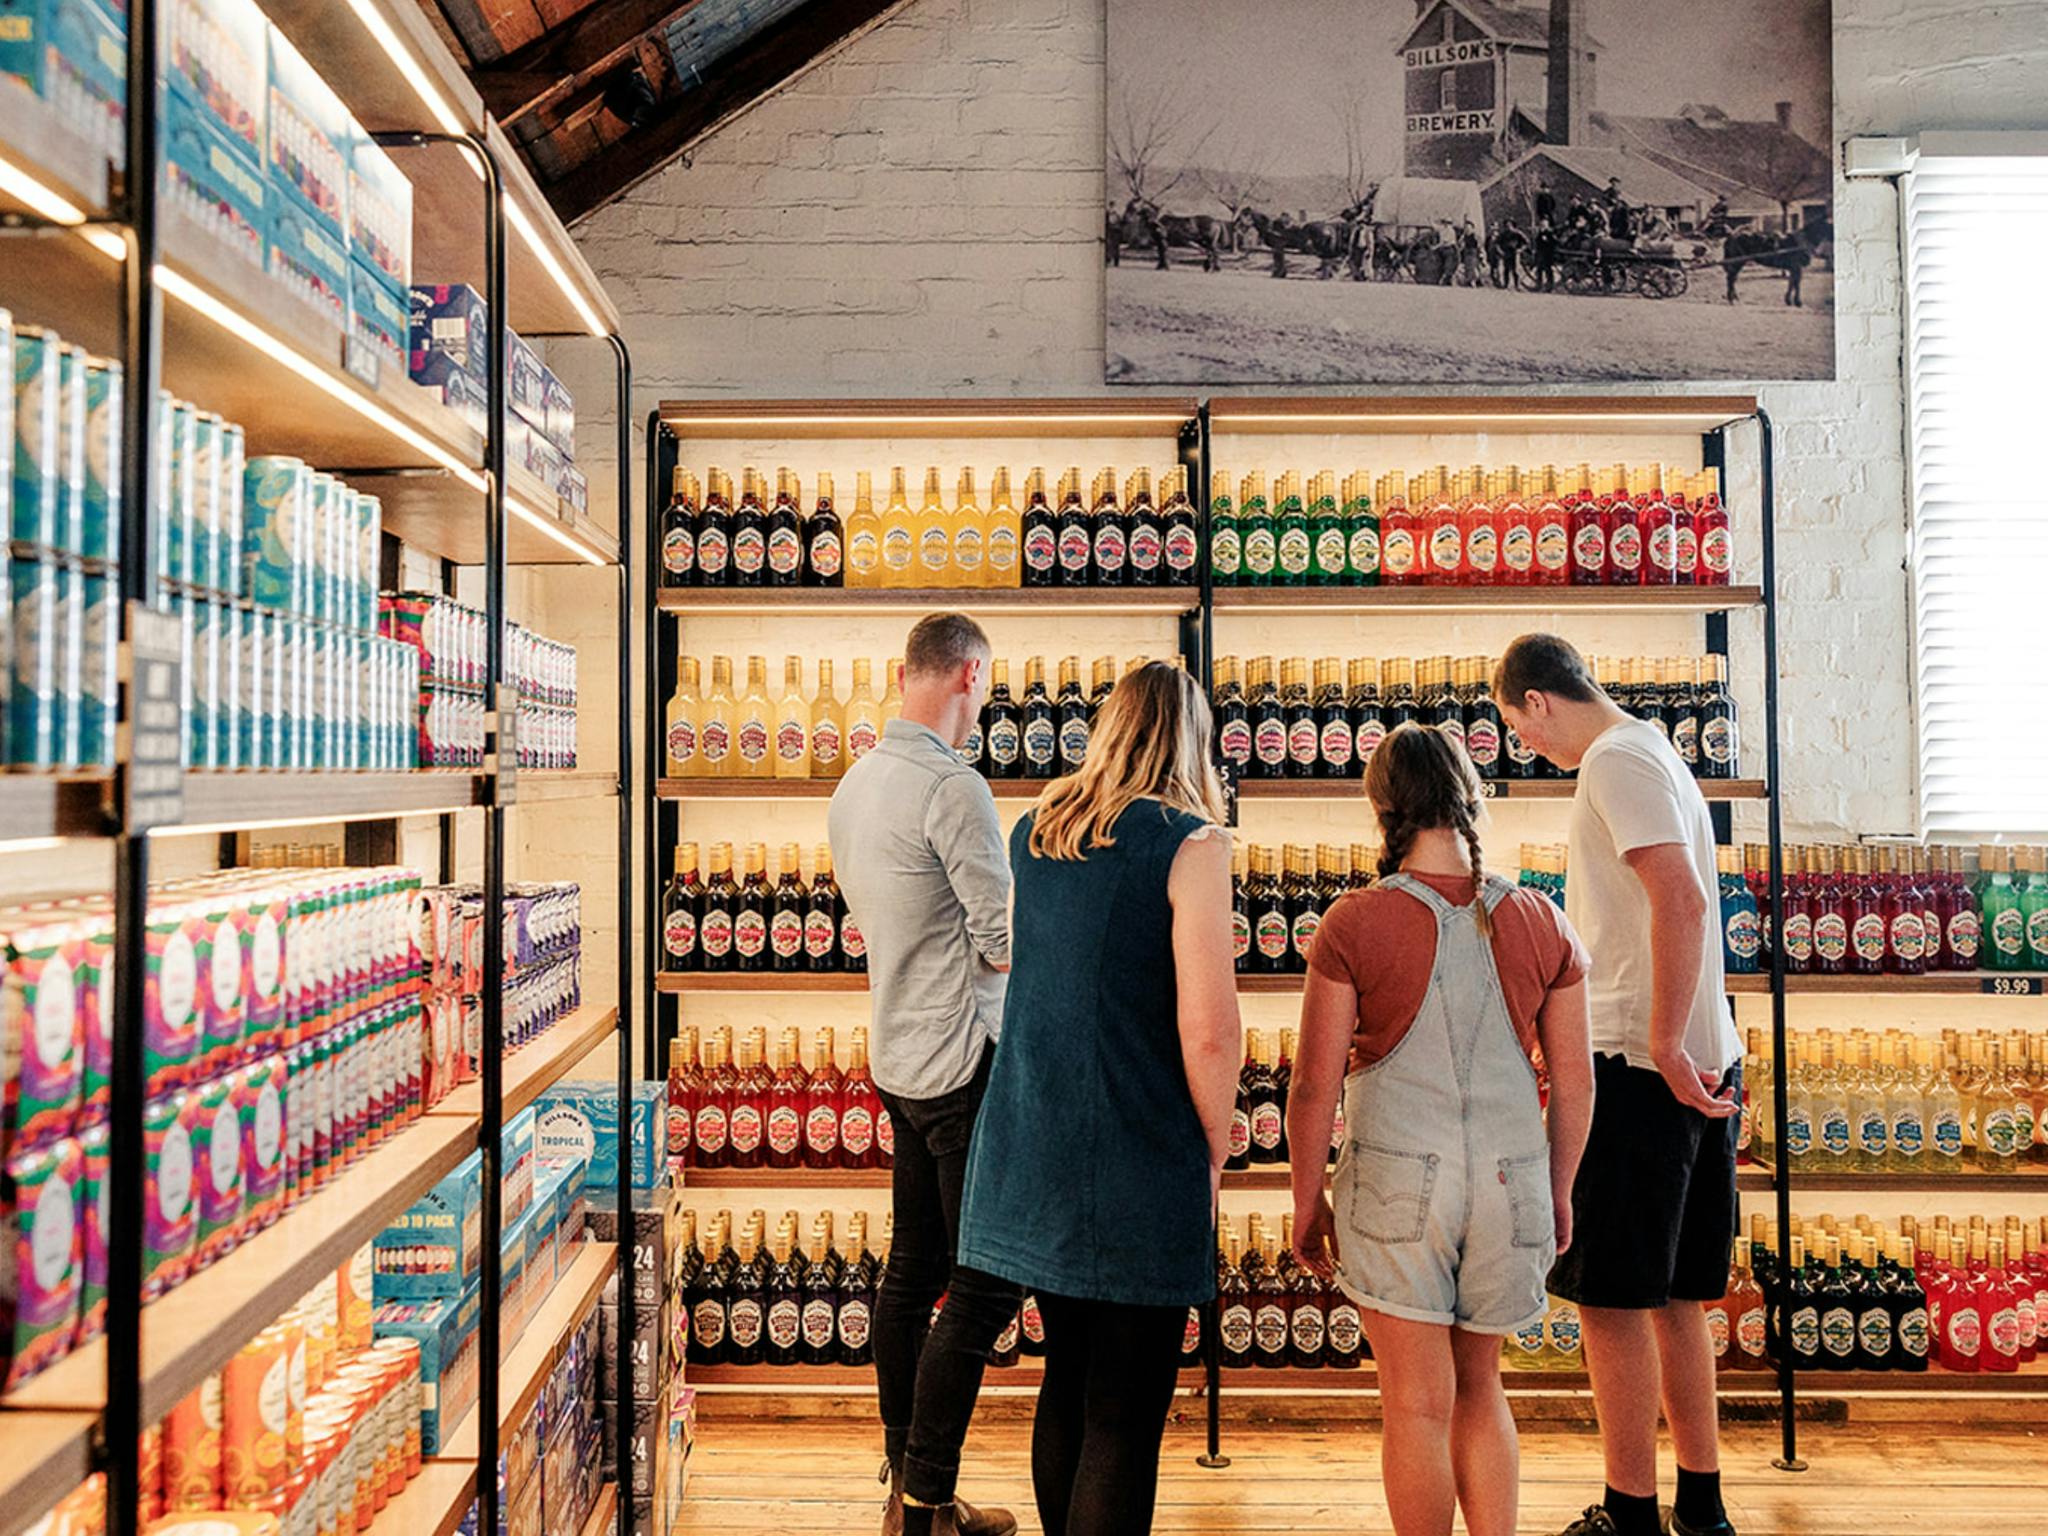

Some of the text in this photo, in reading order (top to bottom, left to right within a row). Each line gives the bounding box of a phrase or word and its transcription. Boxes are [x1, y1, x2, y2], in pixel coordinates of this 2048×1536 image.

[1406, 42, 1494, 67] BILLSON'S
[1994, 978, 2030, 994] $9.99
[541, 1136, 584, 1147] TROPICAL
[425, 1215, 455, 1228] PACK
[633, 1245, 655, 1269] 24
